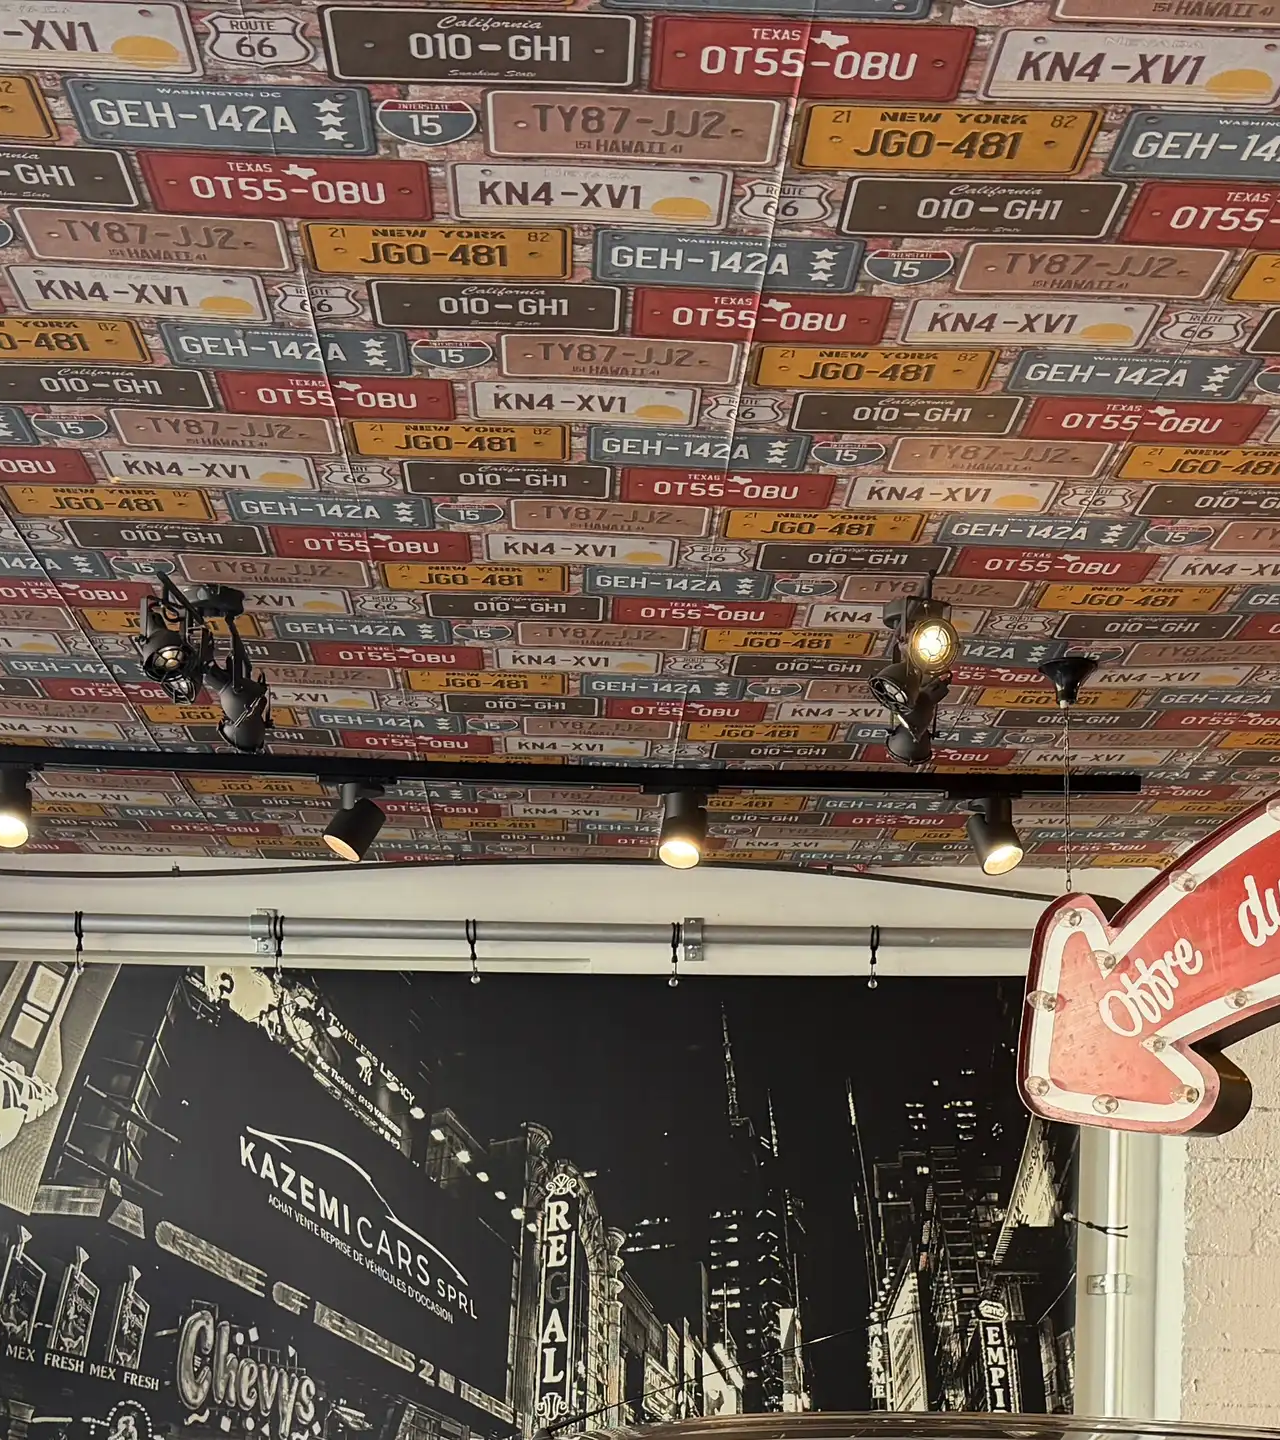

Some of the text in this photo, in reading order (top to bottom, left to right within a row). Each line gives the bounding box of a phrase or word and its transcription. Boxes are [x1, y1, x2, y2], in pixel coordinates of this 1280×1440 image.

[229, 19, 276, 31] ROUTE
[437, 15, 542, 32] California
[752, 29, 801, 41] TEXAS
[234, 36, 278, 58] 66
[91, 100, 296, 134] GEH-142A
[409, 113, 443, 136] 15
[879, 111, 942, 123] NEW
[954, 113, 1029, 126] YORK
[227, 162, 272, 172] TEXAS
[611, 247, 791, 274] GEH-142A
[1098, 936, 1203, 1038] Offre
[239, 1135, 478, 1320] KAZEMI CARS SPRL
[268, 1194, 454, 1324] ACHAT VENTE REPRISE DE VÉHICULES D'OCCASION
[542, 1201, 571, 1384] REGAL
[6, 1343, 35, 1362] MEX
[44, 1353, 84, 1374] FRESH
[90, 1363, 116, 1381] MEX
[124, 1372, 160, 1391] FRESH
[985, 1326, 1007, 1411] EMPI
